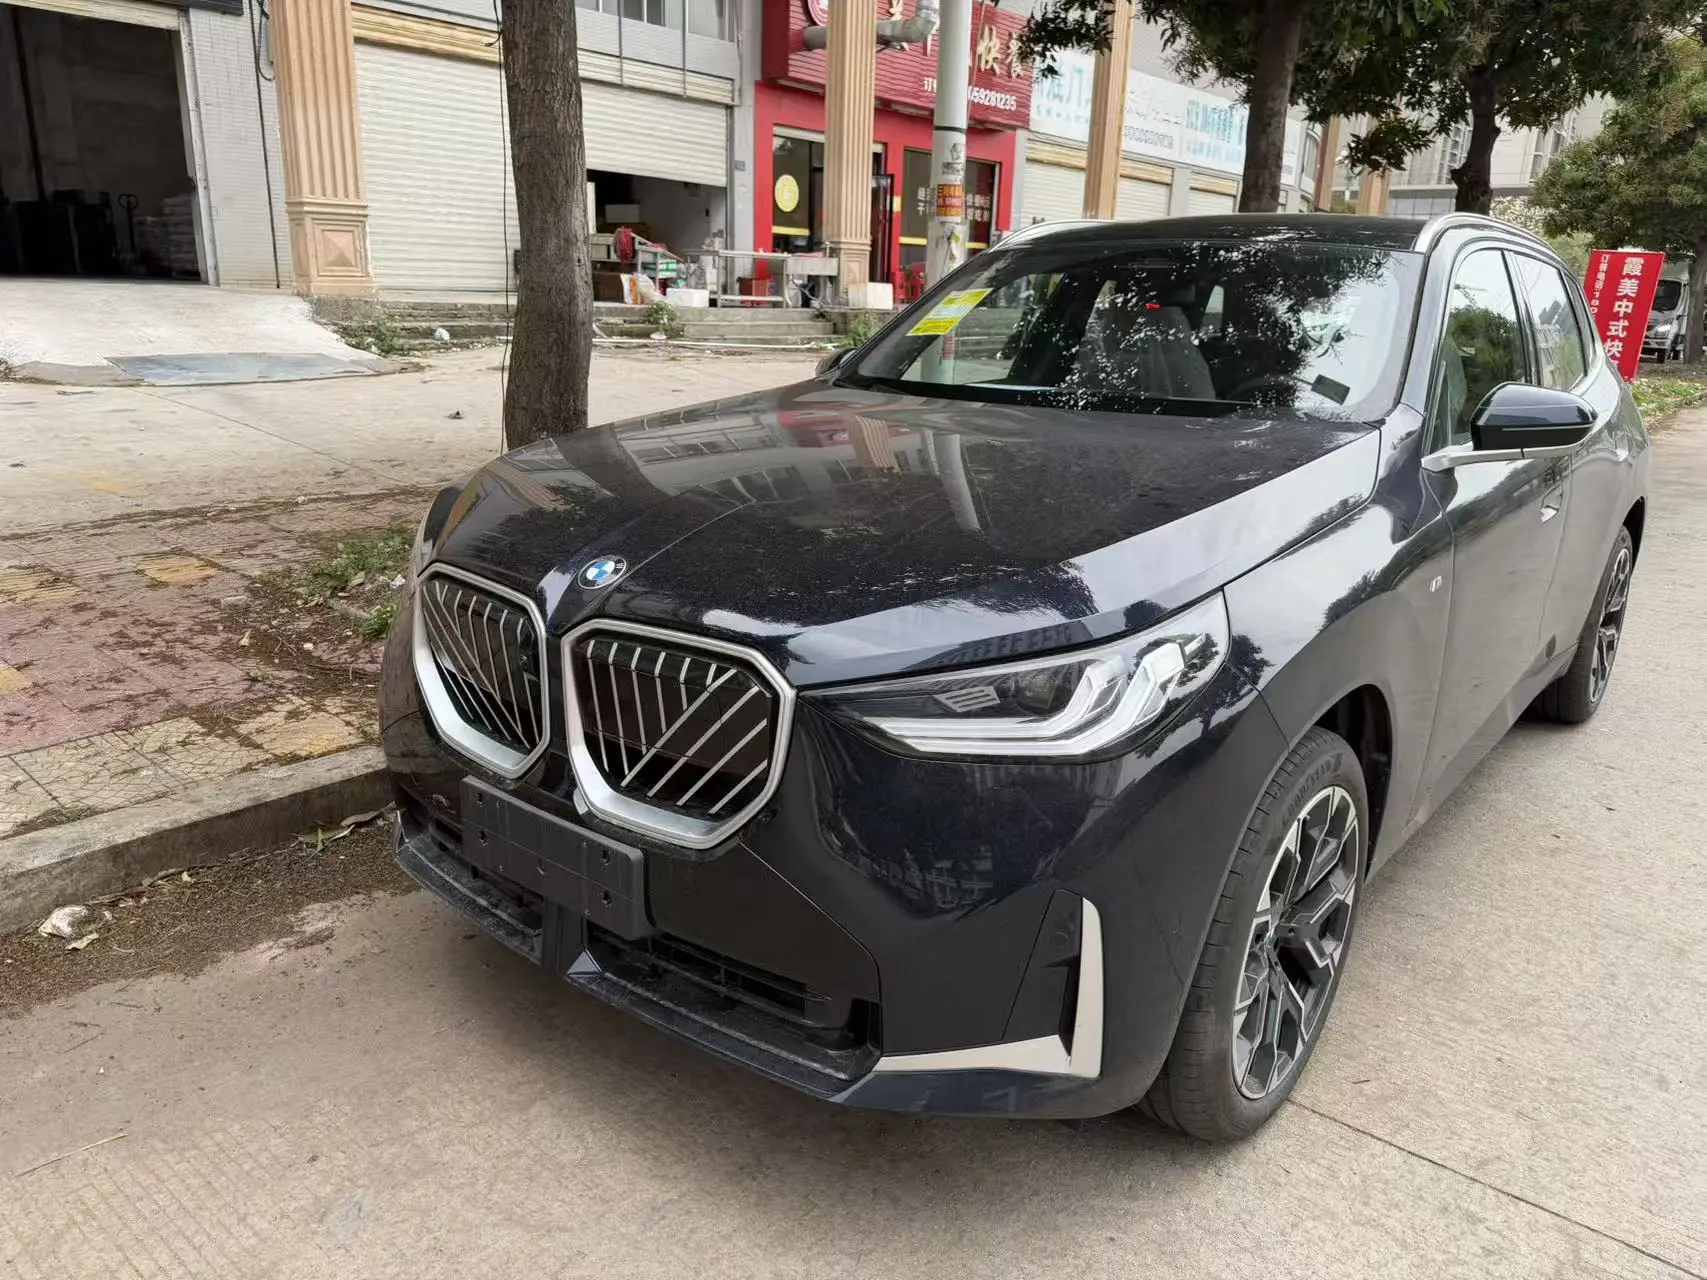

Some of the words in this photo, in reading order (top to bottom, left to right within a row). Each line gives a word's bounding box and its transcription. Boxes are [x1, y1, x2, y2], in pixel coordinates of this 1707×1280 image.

[1603, 256, 1645, 369] 霞美中式快
